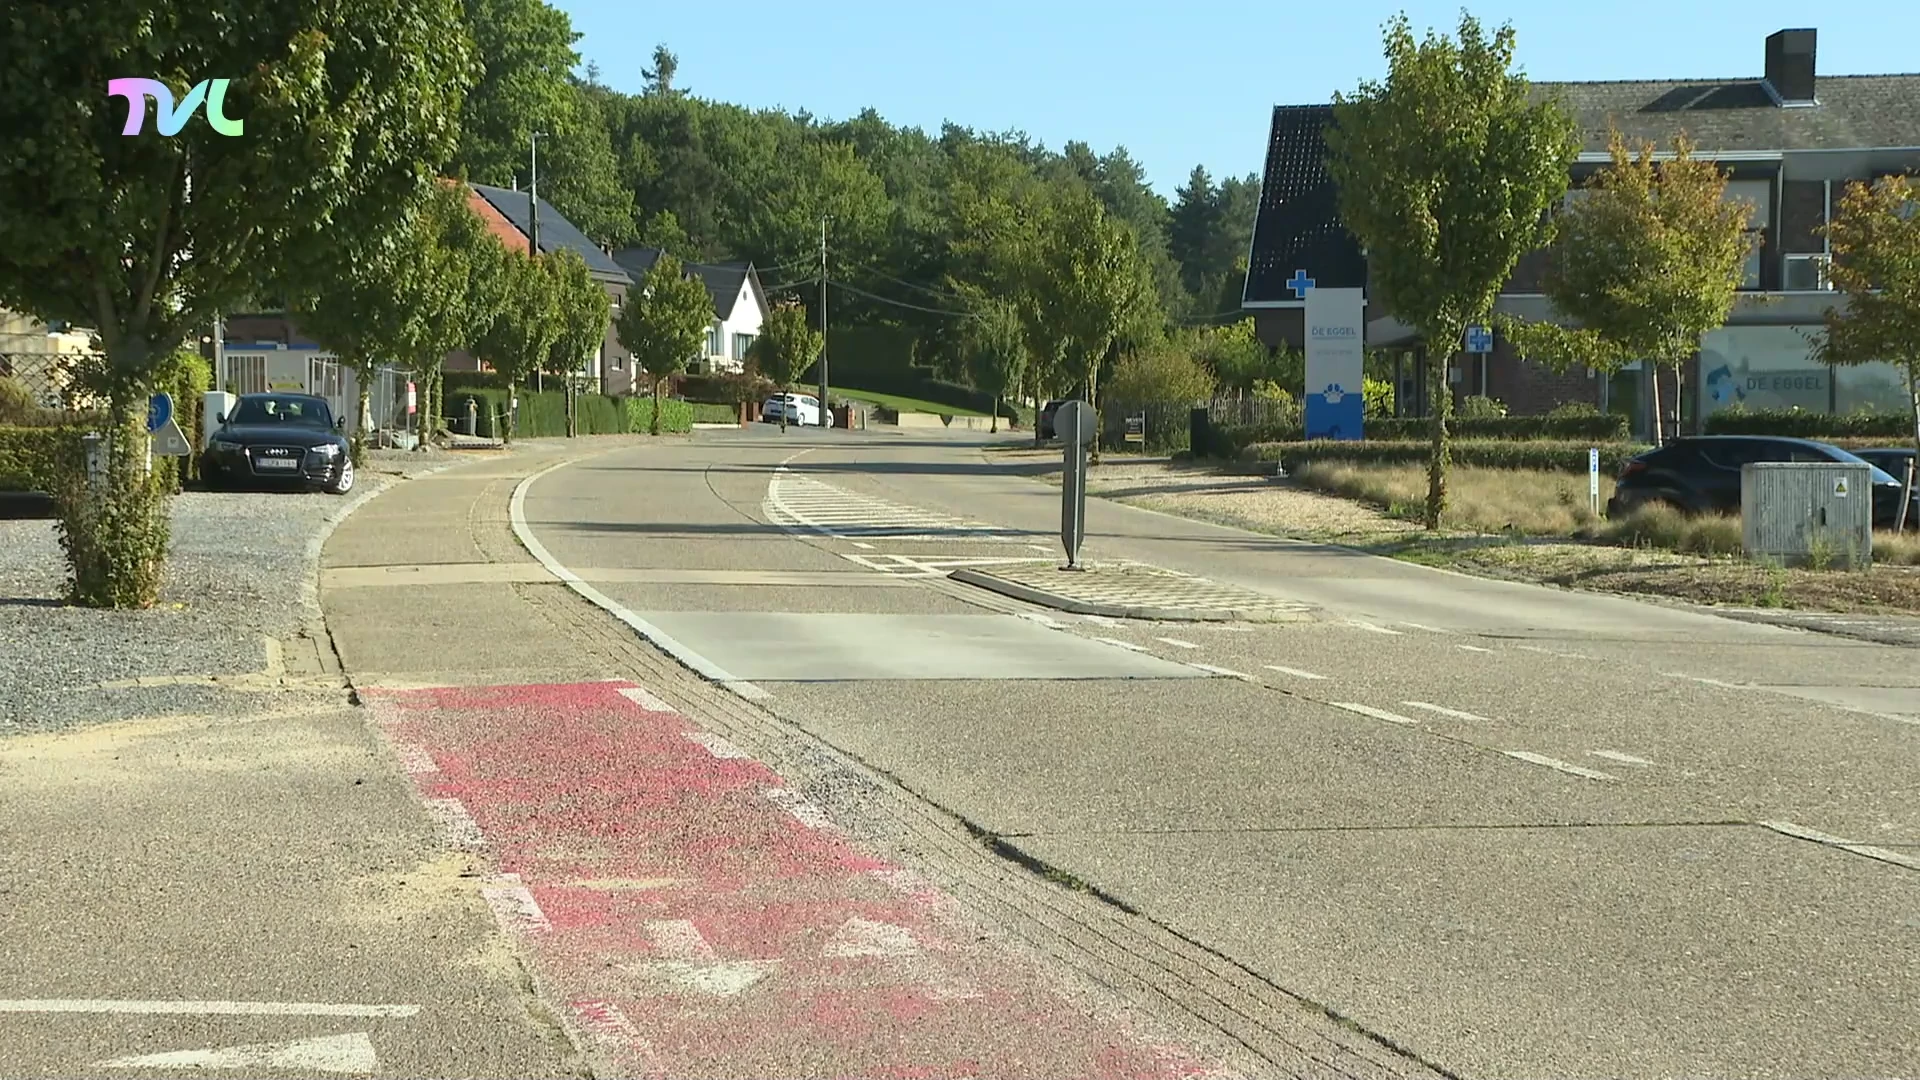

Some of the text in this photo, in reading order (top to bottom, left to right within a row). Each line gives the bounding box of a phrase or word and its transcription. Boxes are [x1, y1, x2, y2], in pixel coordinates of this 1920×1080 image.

[1312, 327, 1357, 336] DE EGGEL
[1746, 377, 1824, 391] DE EGGEL
